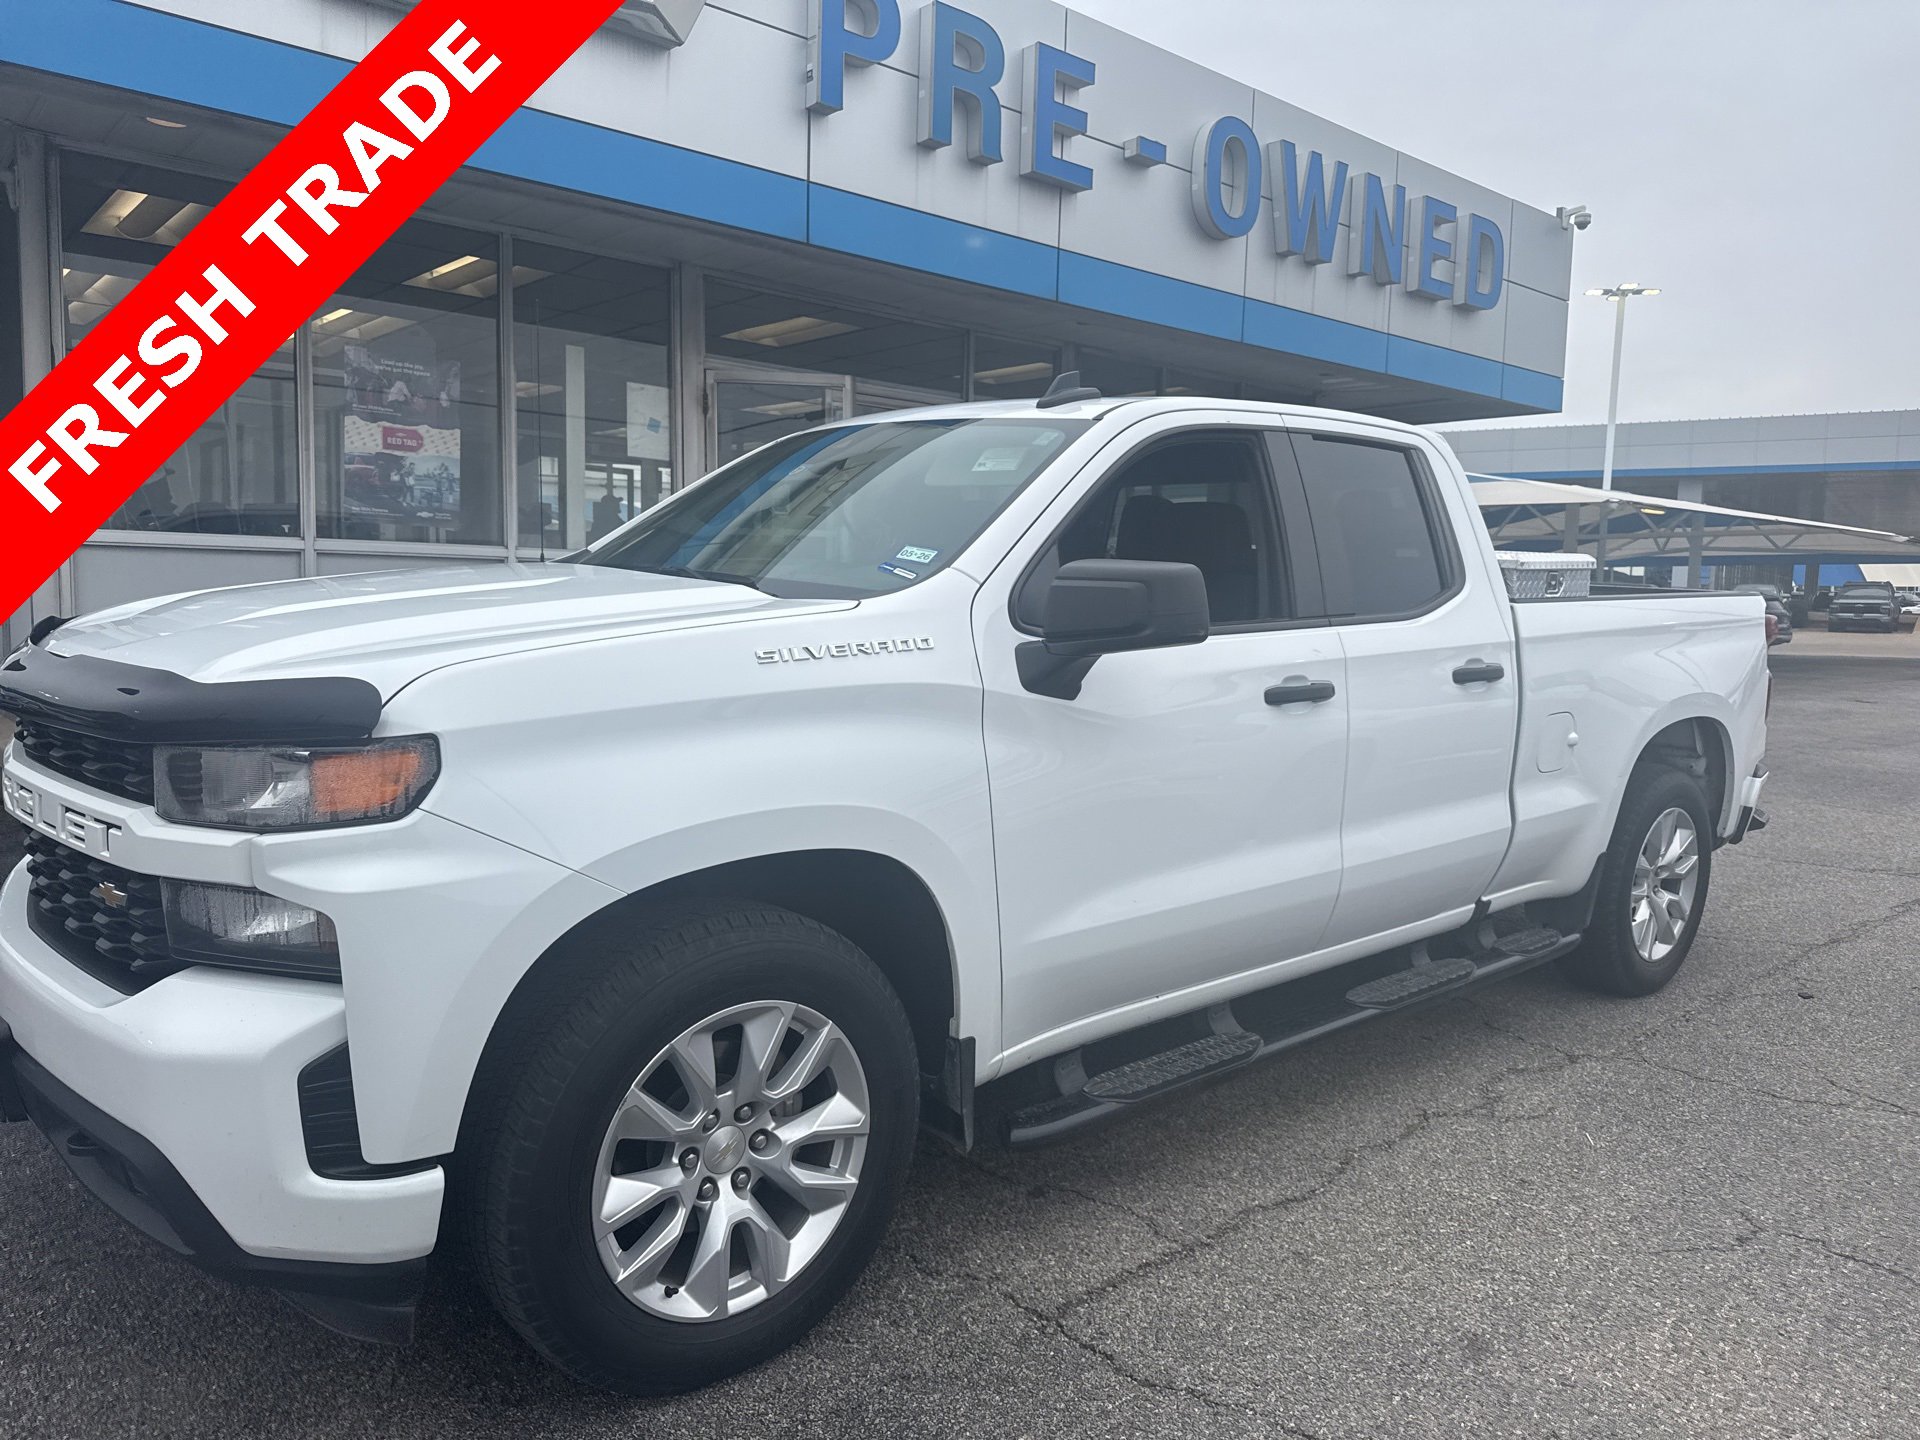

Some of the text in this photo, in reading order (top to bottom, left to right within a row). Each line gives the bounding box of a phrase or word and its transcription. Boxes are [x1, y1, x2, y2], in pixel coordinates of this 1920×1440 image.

[387, 436, 417, 447] RED TAG
[755, 635, 935, 665] SILVERADO
